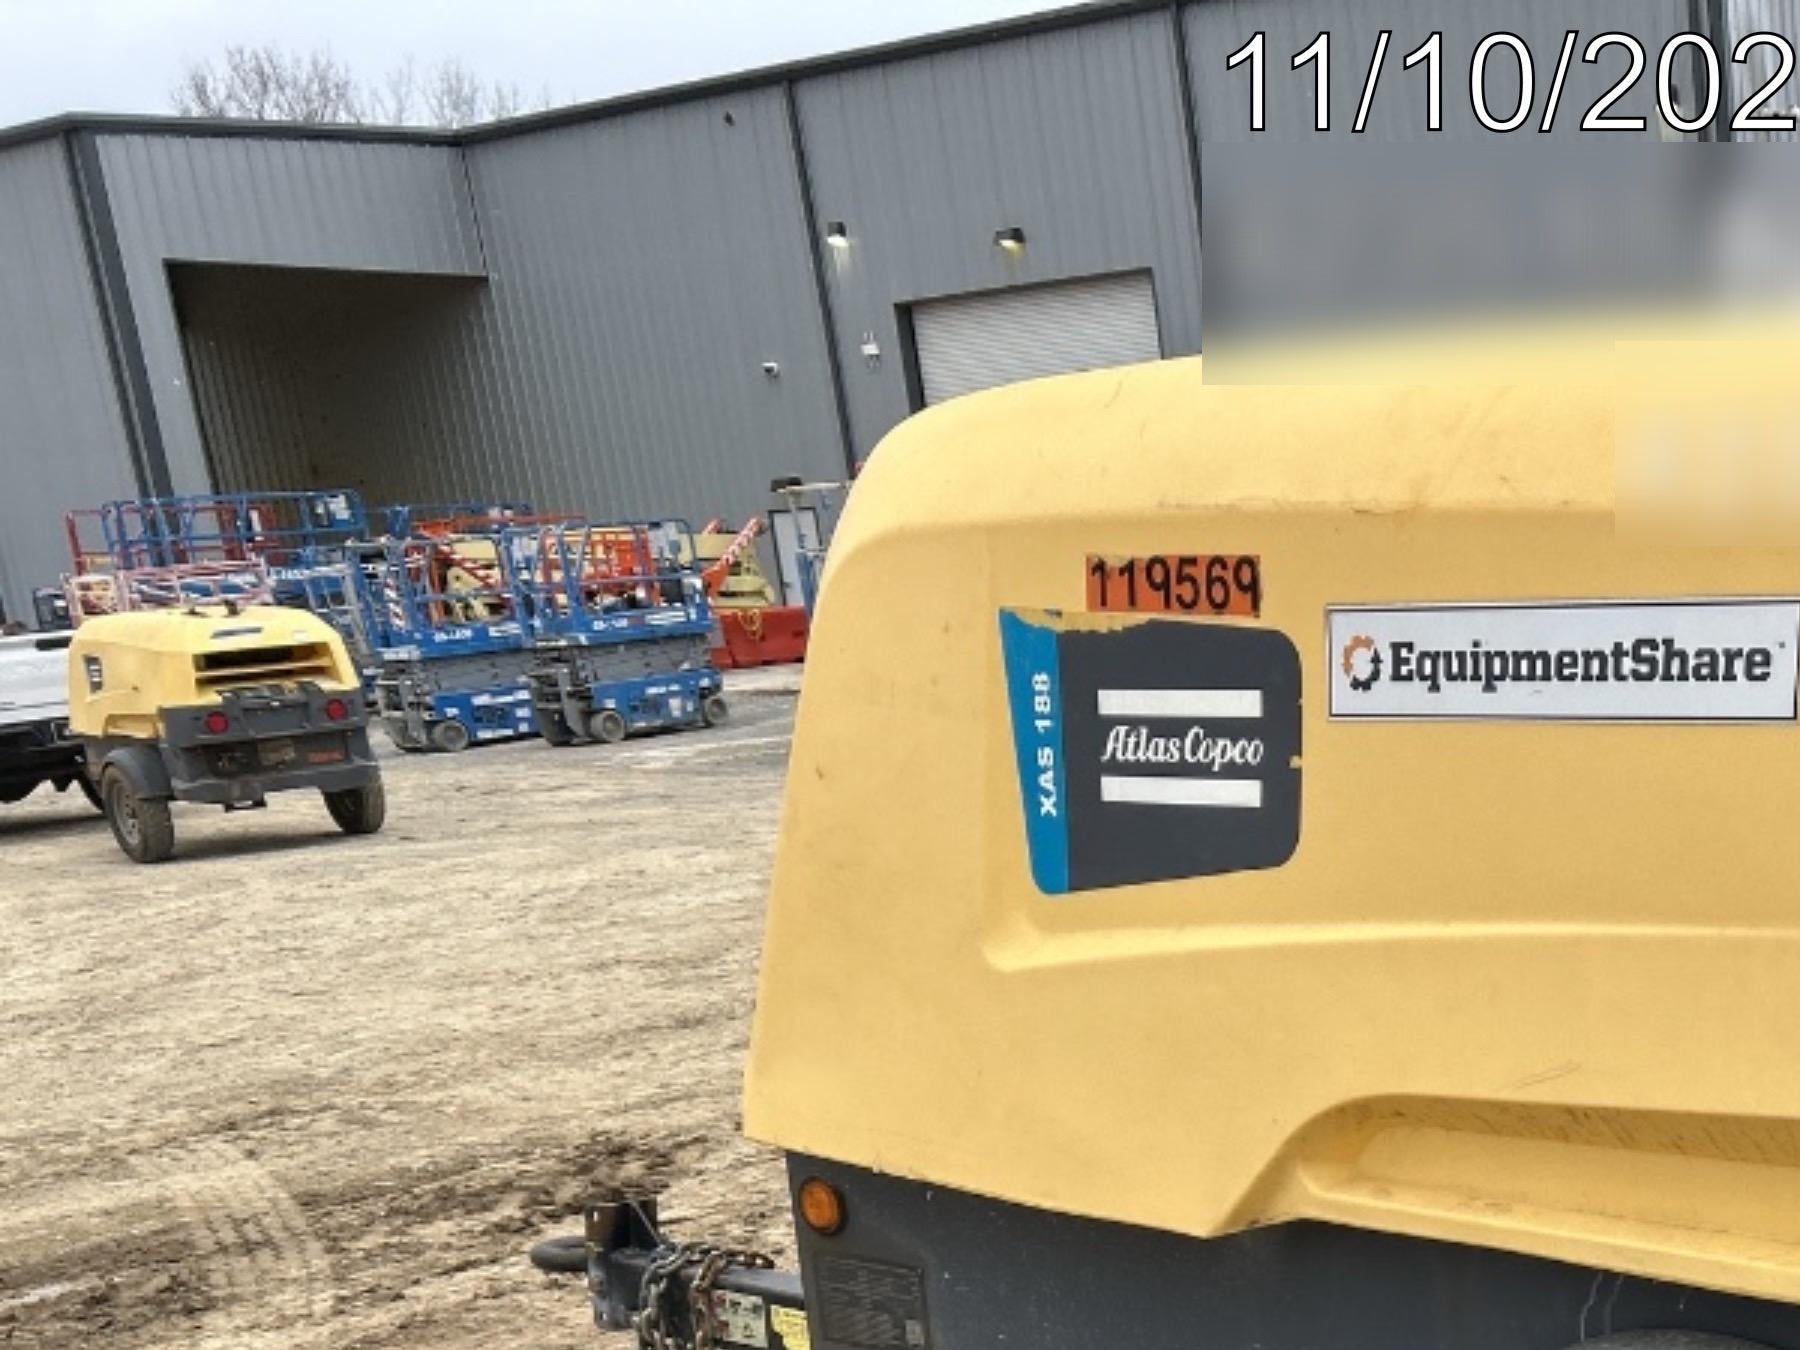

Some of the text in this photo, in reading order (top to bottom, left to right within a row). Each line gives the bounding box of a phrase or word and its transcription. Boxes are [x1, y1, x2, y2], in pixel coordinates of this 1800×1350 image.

[1090, 555, 1261, 614] 119569
[1388, 638, 1772, 692] EquipmentShare
[1031, 671, 1058, 817] XAS 188
[1101, 725, 1264, 772] Atlas Copco
